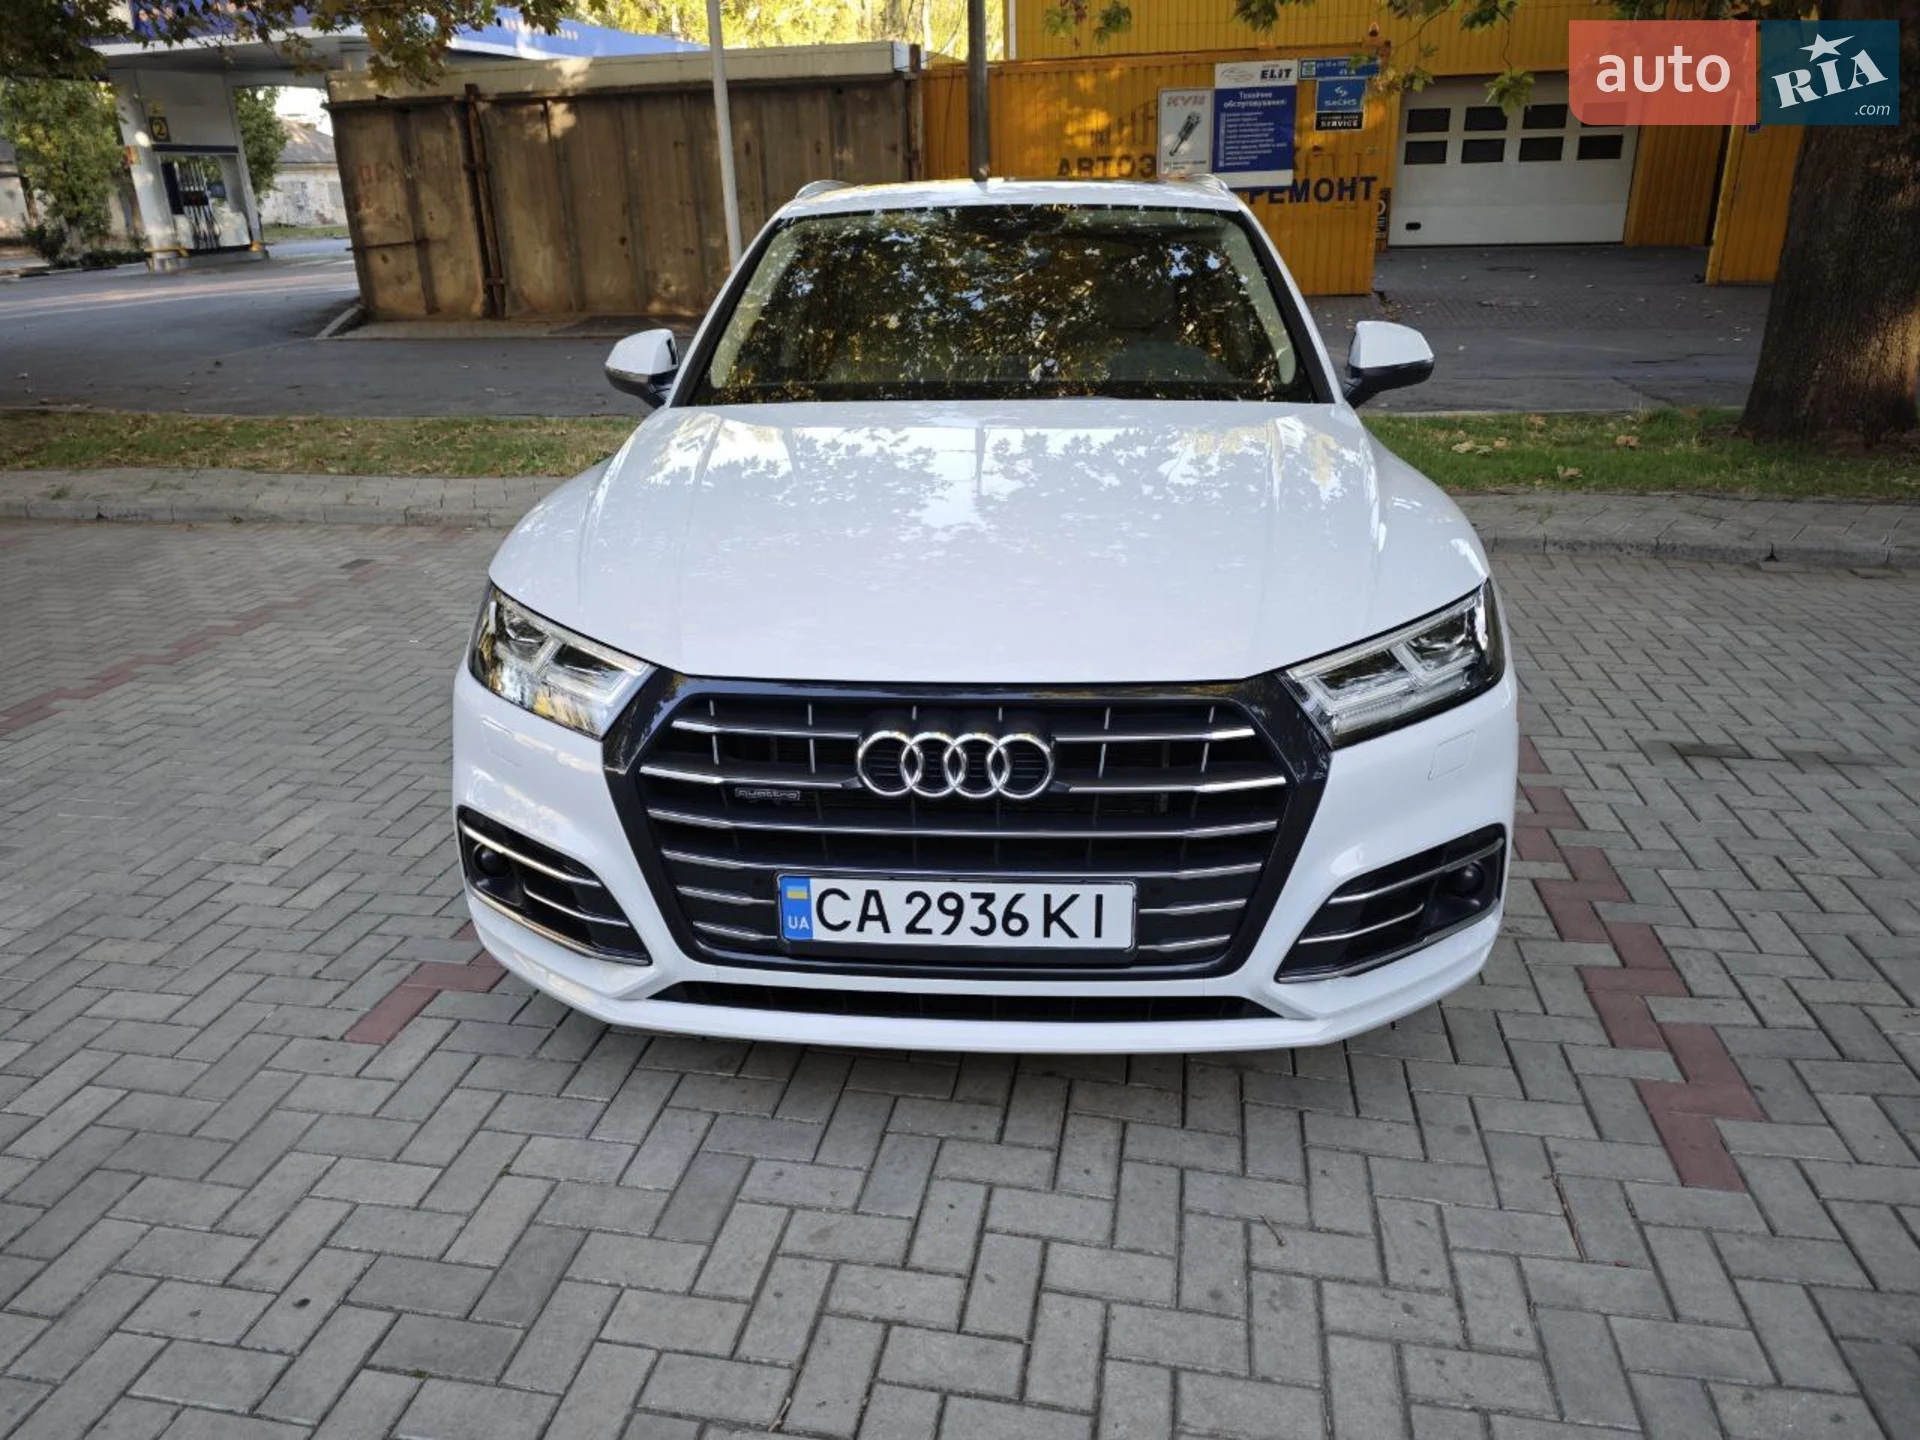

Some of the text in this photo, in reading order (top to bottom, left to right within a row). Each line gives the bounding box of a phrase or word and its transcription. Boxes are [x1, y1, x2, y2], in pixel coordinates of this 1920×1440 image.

[788, 915, 810, 930] UA
[815, 887, 1104, 939] CA 2936 KI
